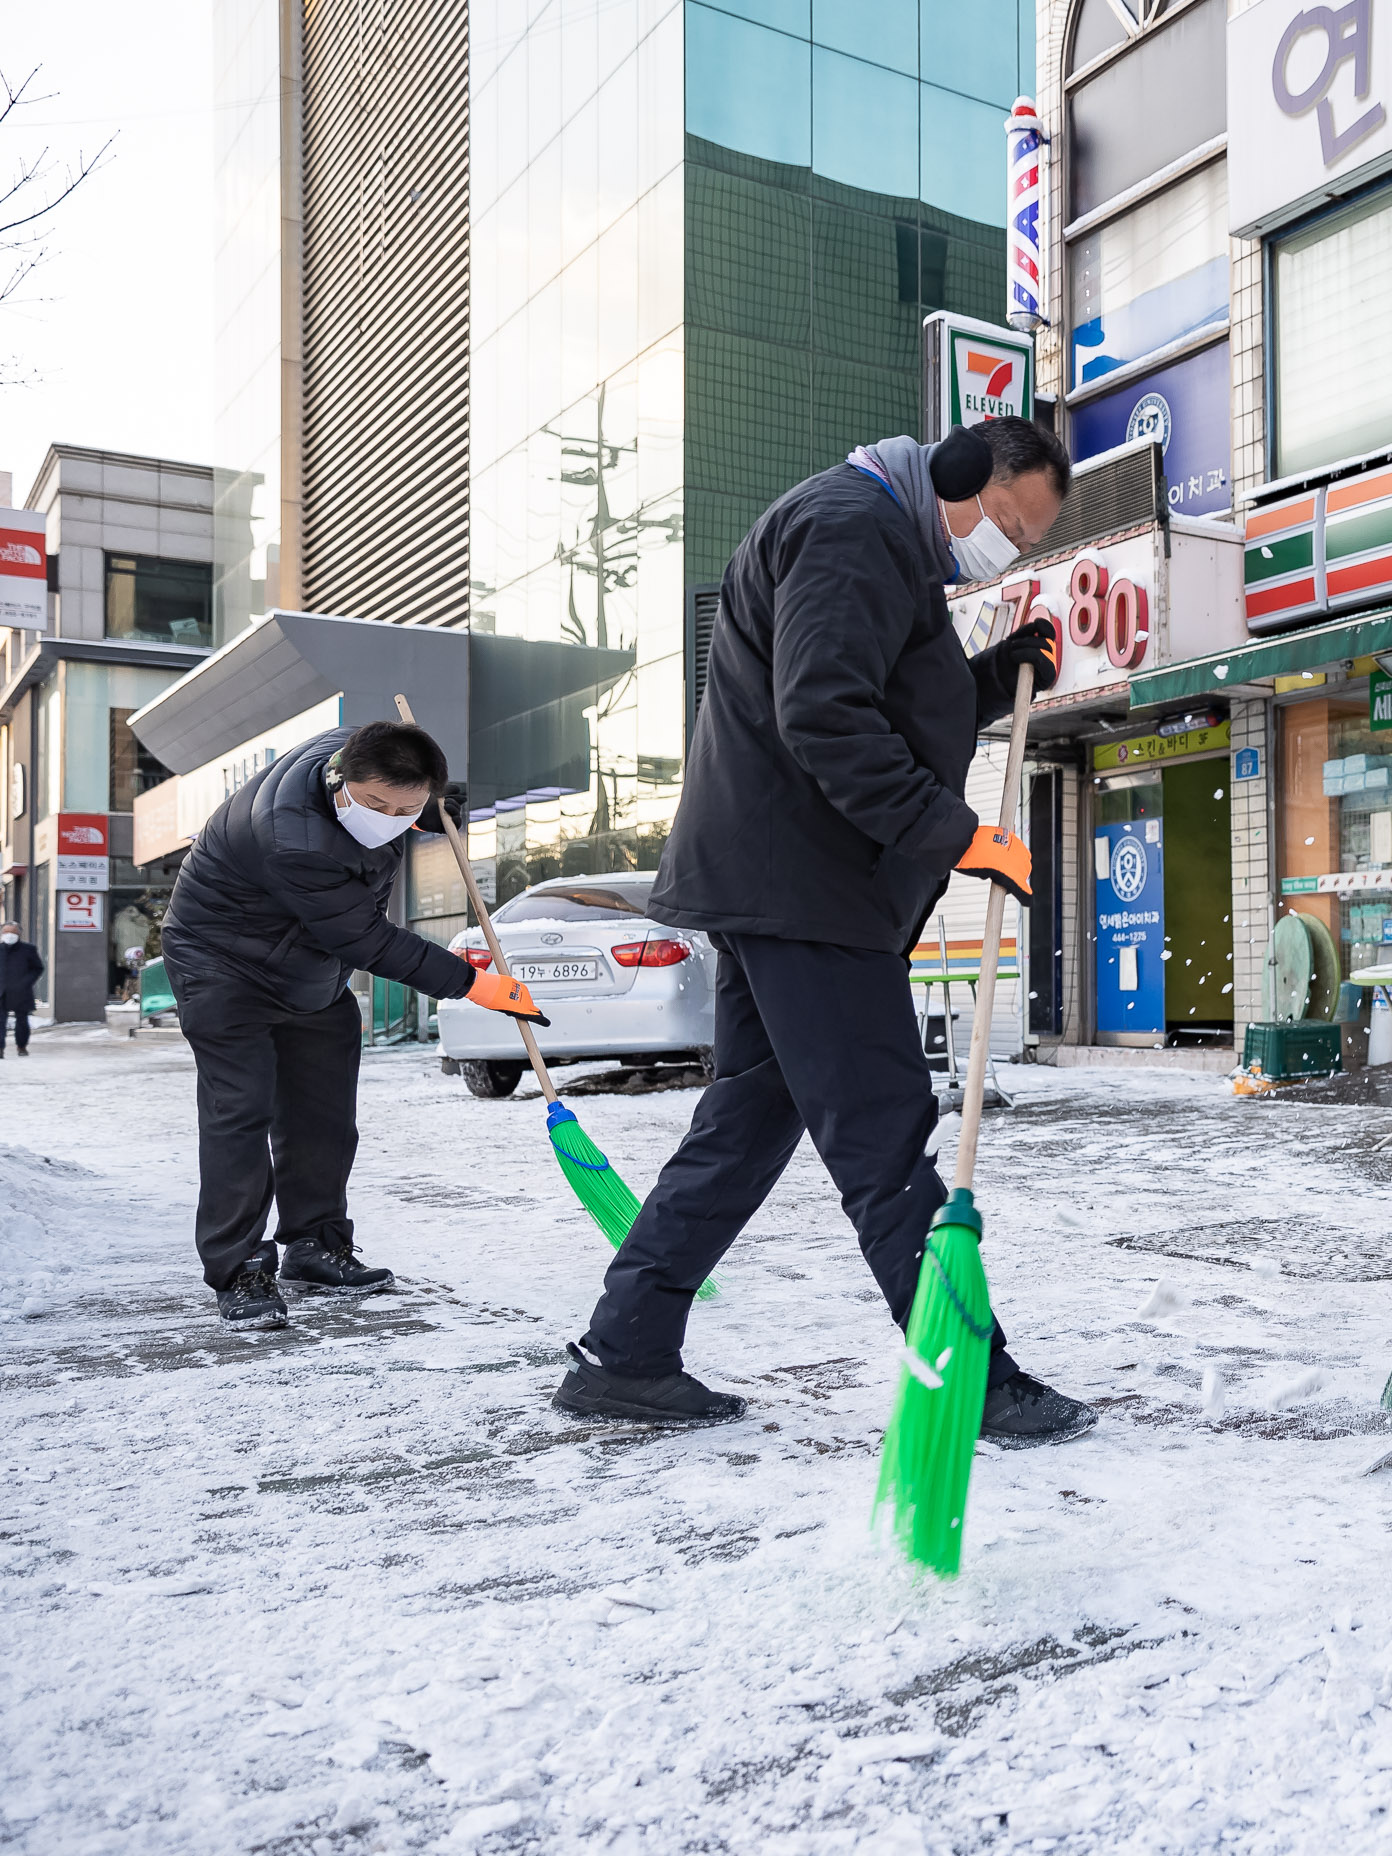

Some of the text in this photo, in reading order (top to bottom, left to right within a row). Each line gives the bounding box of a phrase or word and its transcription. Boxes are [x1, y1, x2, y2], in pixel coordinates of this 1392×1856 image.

[1002, 556, 1150, 690] 780
[1241, 761, 1253, 776] 87
[520, 964, 589, 980] 19누 6896
